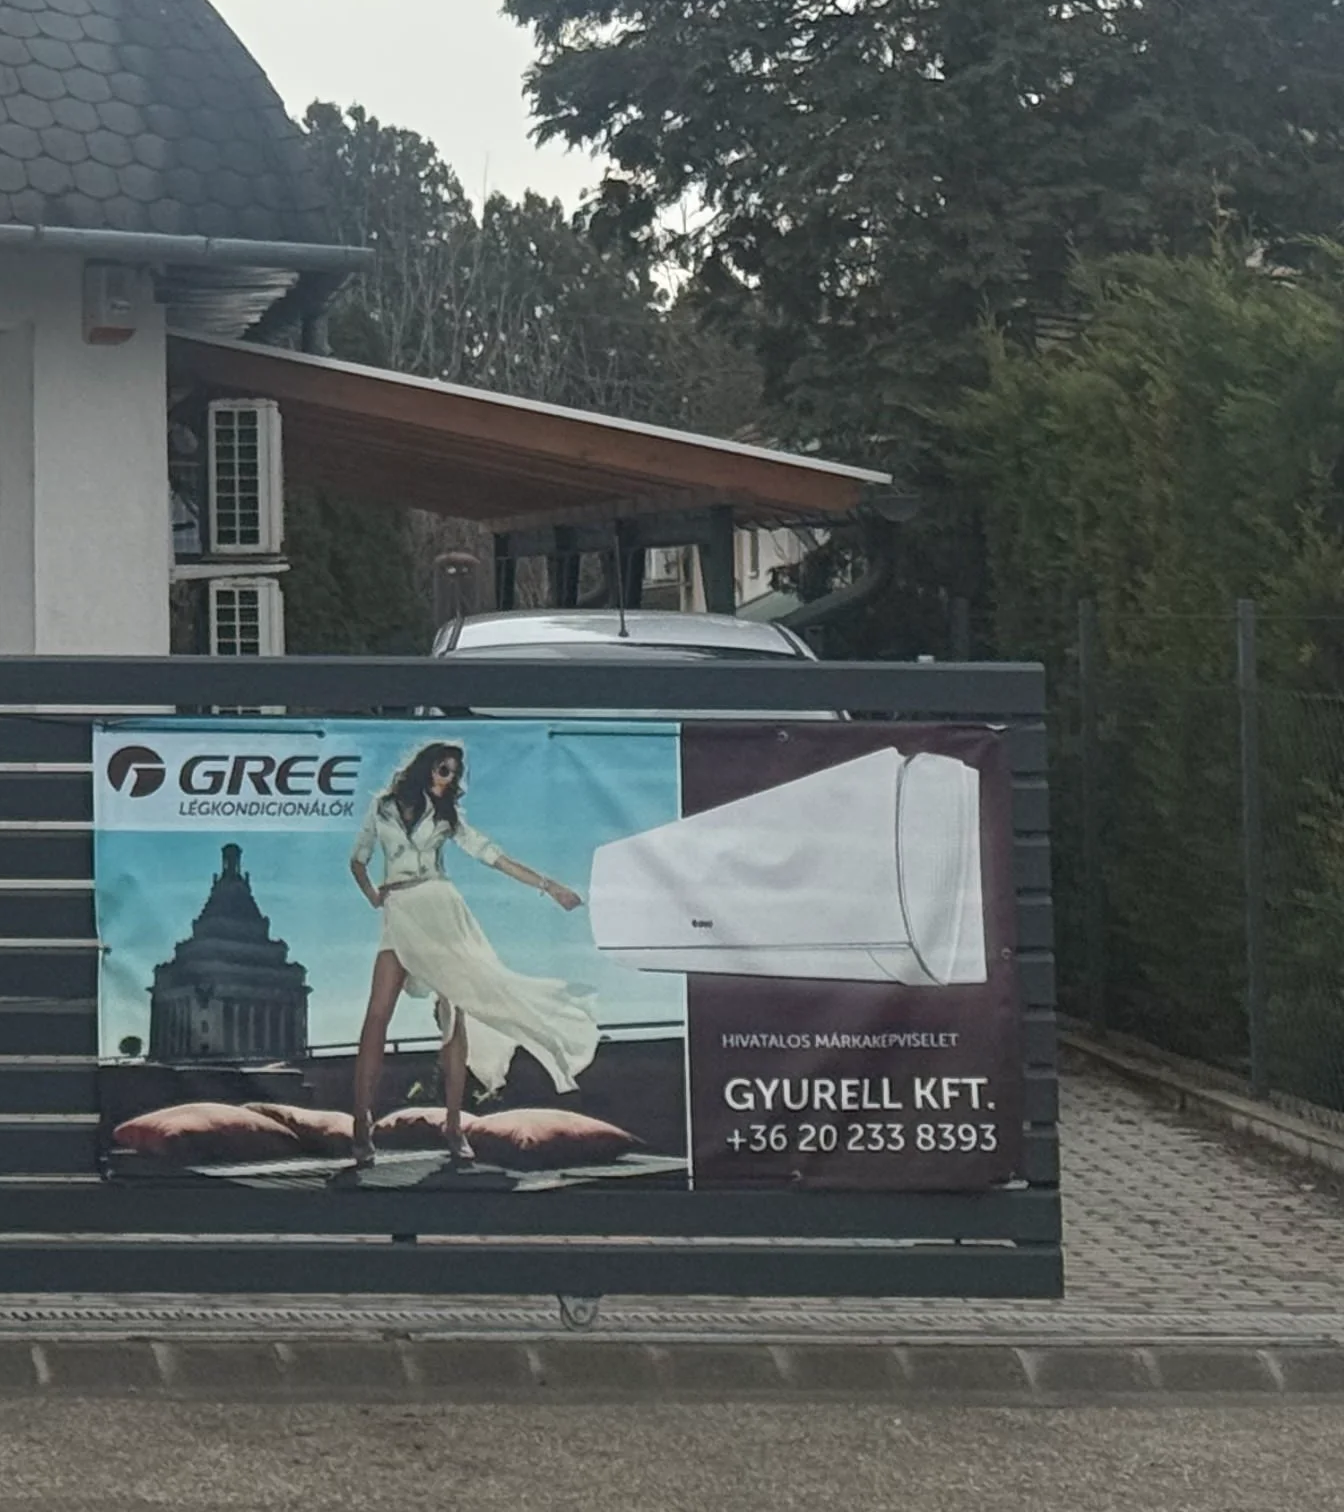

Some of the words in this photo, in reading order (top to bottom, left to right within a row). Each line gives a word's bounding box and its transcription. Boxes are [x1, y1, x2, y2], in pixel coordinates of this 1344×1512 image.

[179, 755, 361, 795] GREE
[179, 800, 355, 817] LÉGKONDICIONÁLÓK
[722, 1034, 811, 1049] HIVATALOS
[814, 1031, 959, 1048] MÁRKAKÉPVISELET
[724, 1077, 903, 1110] GYURELL
[914, 1077, 995, 1110] KFT.
[726, 1124, 788, 1151] +36
[798, 1124, 838, 1151] 20
[848, 1124, 905, 1151] 233
[916, 1123, 997, 1151] 8393
